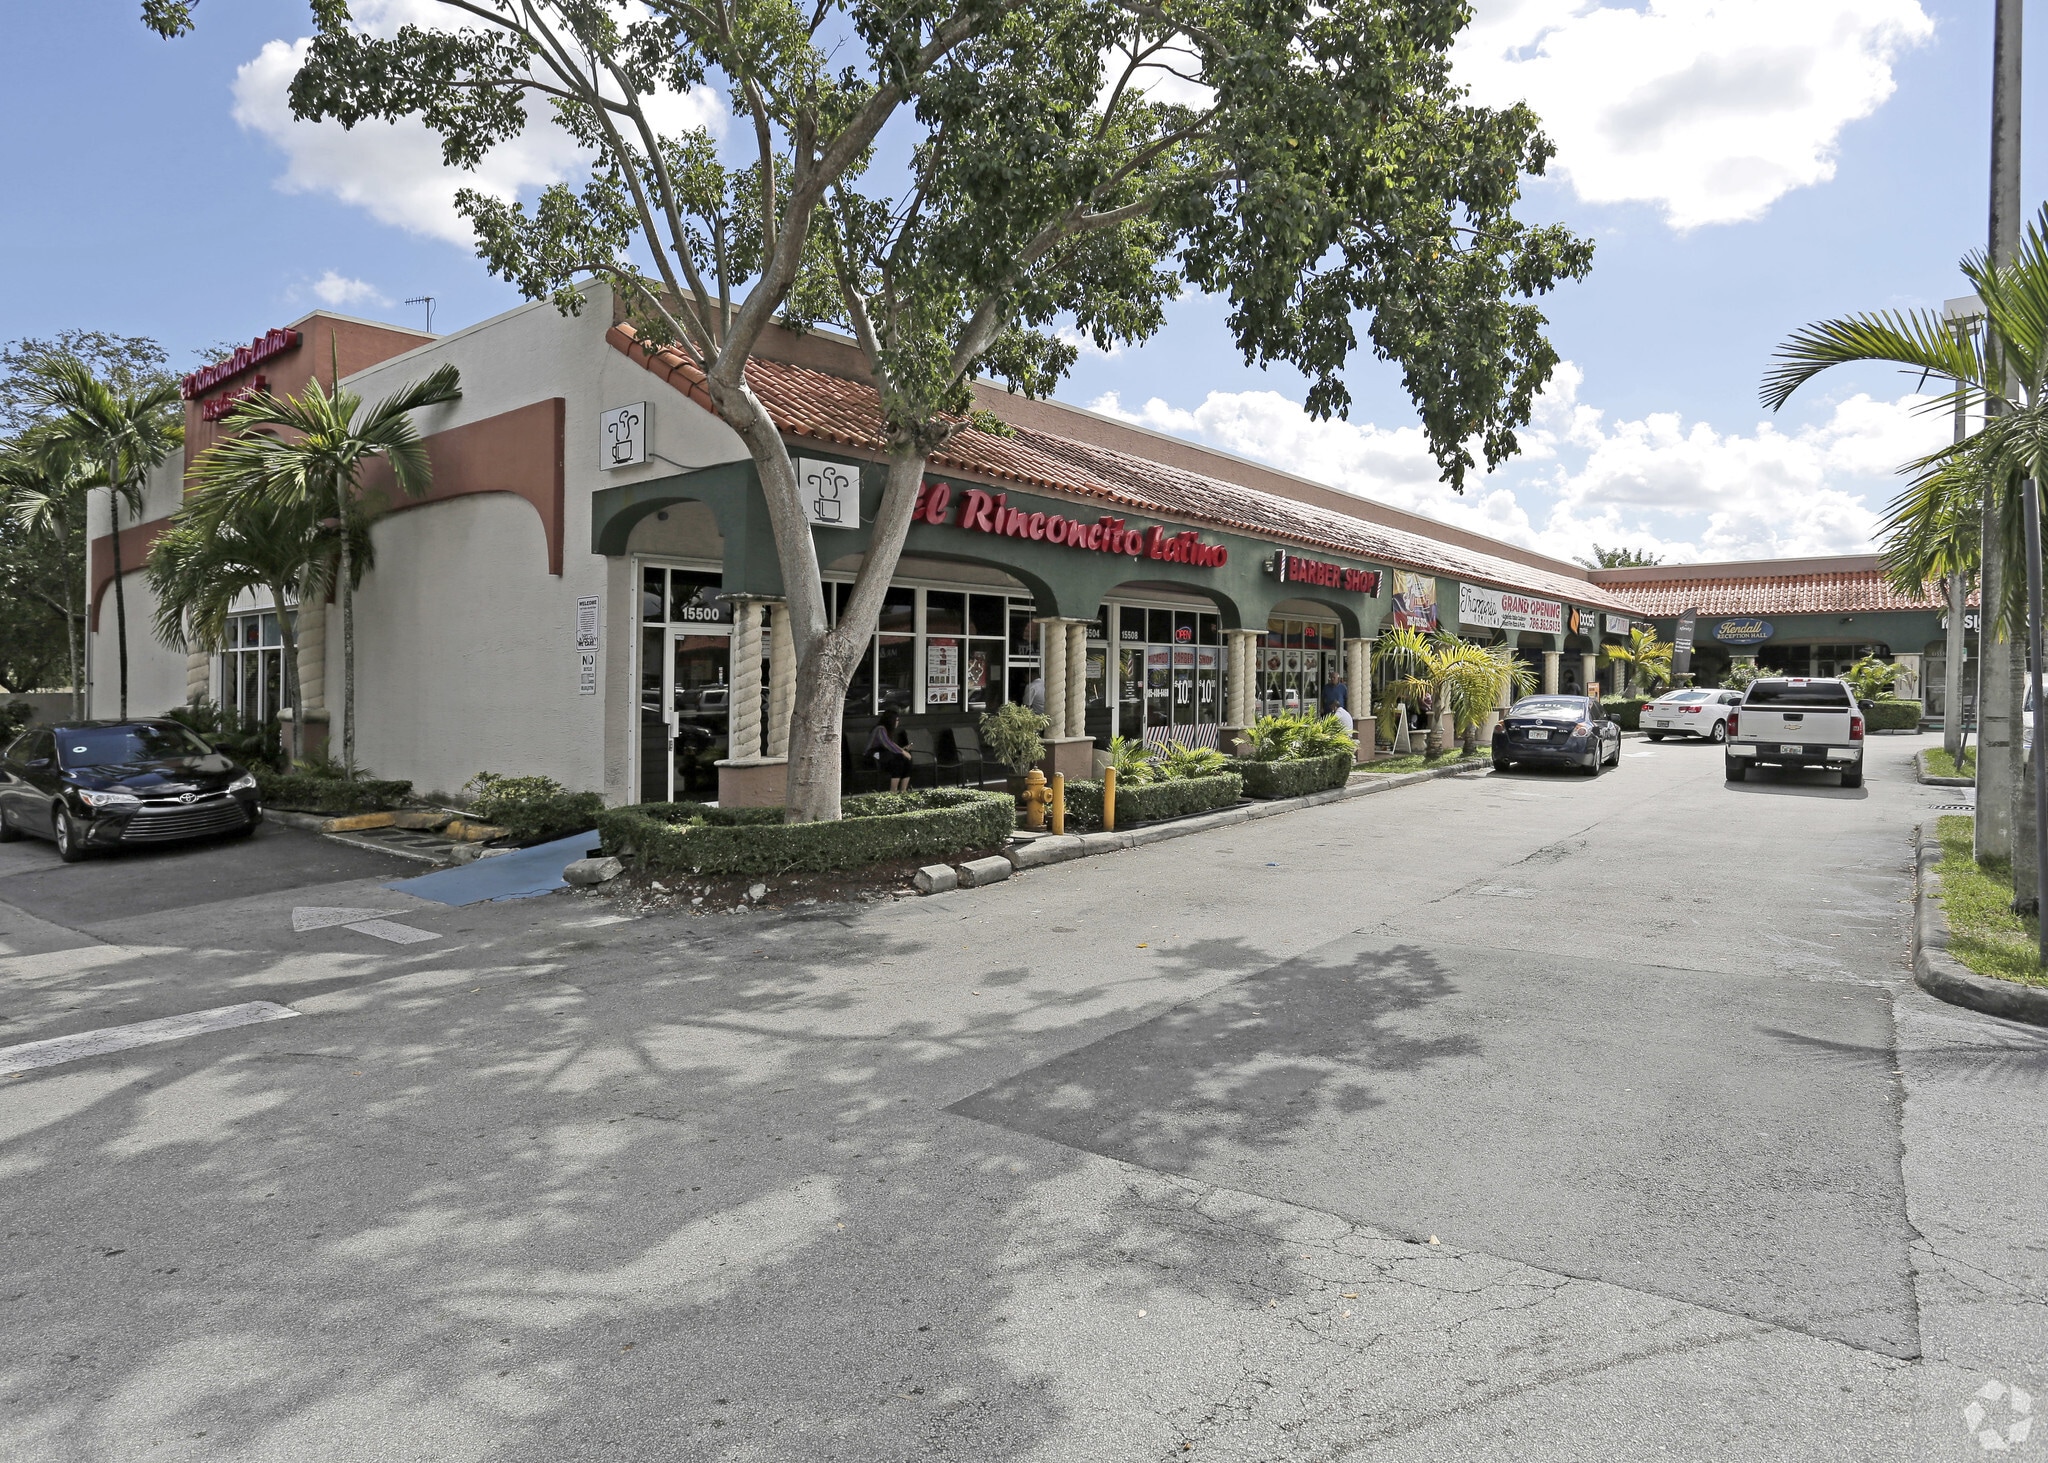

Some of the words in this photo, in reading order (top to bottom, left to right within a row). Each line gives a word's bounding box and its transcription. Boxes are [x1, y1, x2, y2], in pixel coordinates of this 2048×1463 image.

[956, 488, 1143, 556] Rinconcito
[1143, 524, 1228, 568] Latino
[1288, 555, 1342, 589] BARBER
[1343, 567, 1376, 593] SHOP
[1501, 594, 1529, 614] GRAND
[1530, 600, 1560, 619] OPENING
[682, 607, 720, 621] 15500
[1579, 609, 1595, 628] boost
[1719, 621, 1762, 634] Kendall
[1122, 630, 1139, 640] 15508
[1175, 629, 1192, 641] OPEN
[582, 655, 594, 666] NO
[1174, 652, 1194, 665] BARBER
[1199, 654, 1214, 666] SHOP
